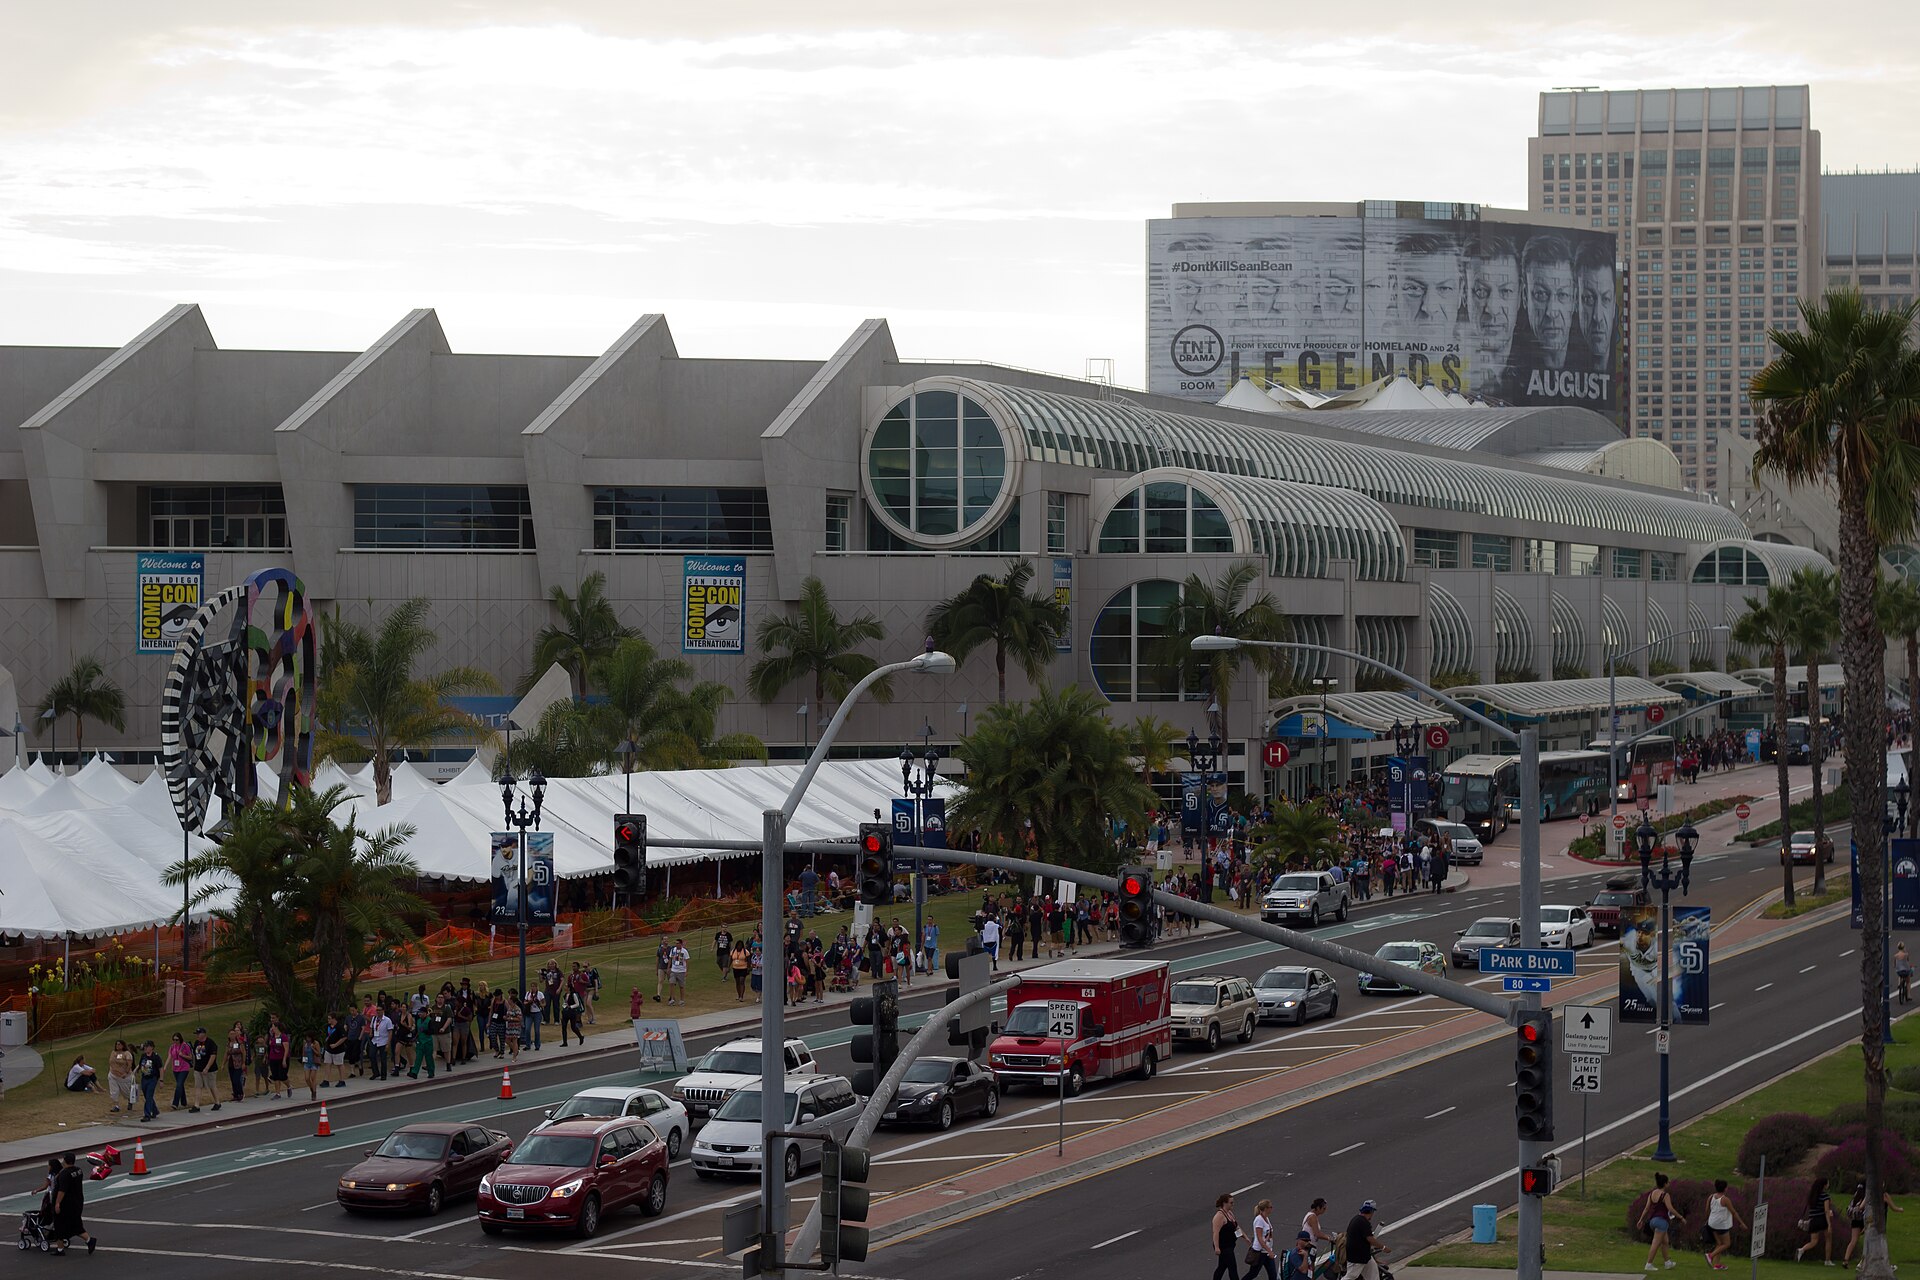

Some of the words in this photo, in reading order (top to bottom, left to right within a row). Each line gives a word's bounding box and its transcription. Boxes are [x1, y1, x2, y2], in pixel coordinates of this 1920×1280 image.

[1171, 261, 1293, 273] #DontKillSeanBean
[1179, 340, 1216, 354] TNT
[1364, 341, 1428, 351] HOMELAND
[1447, 343, 1460, 352] 24
[1180, 381, 1215, 390] BOOM
[1526, 369, 1610, 400] AUGUST
[140, 558, 187, 569] Welcome
[189, 560, 202, 570] to
[686, 560, 731, 572] Welcome
[733, 564, 744, 572] to
[162, 585, 197, 603] CON
[707, 586, 739, 604] CON
[143, 585, 160, 639] COMIC
[688, 586, 705, 639] COMIC
[141, 640, 178, 648] INTERNATI
[686, 640, 740, 648] INTERNATIONAL
[1651, 709, 1660, 720] F
[1431, 731, 1443, 745] G
[1270, 747, 1282, 763] H
[532, 861, 549, 887] SD
[494, 906, 506, 916] 23
[1680, 941, 1703, 975] SD
[1512, 979, 1523, 989] 80
[1050, 1003, 1075, 1011] SPEED
[1623, 999, 1637, 1010] 25
[1050, 1021, 1075, 1035] 45
[1565, 1033, 1587, 1041] Gaslamp
[1572, 1056, 1600, 1064] SPEED
[1574, 1065, 1597, 1073] LIMIT
[1572, 1075, 1598, 1090] 45
[1753, 1240, 1764, 1251] ONLY
